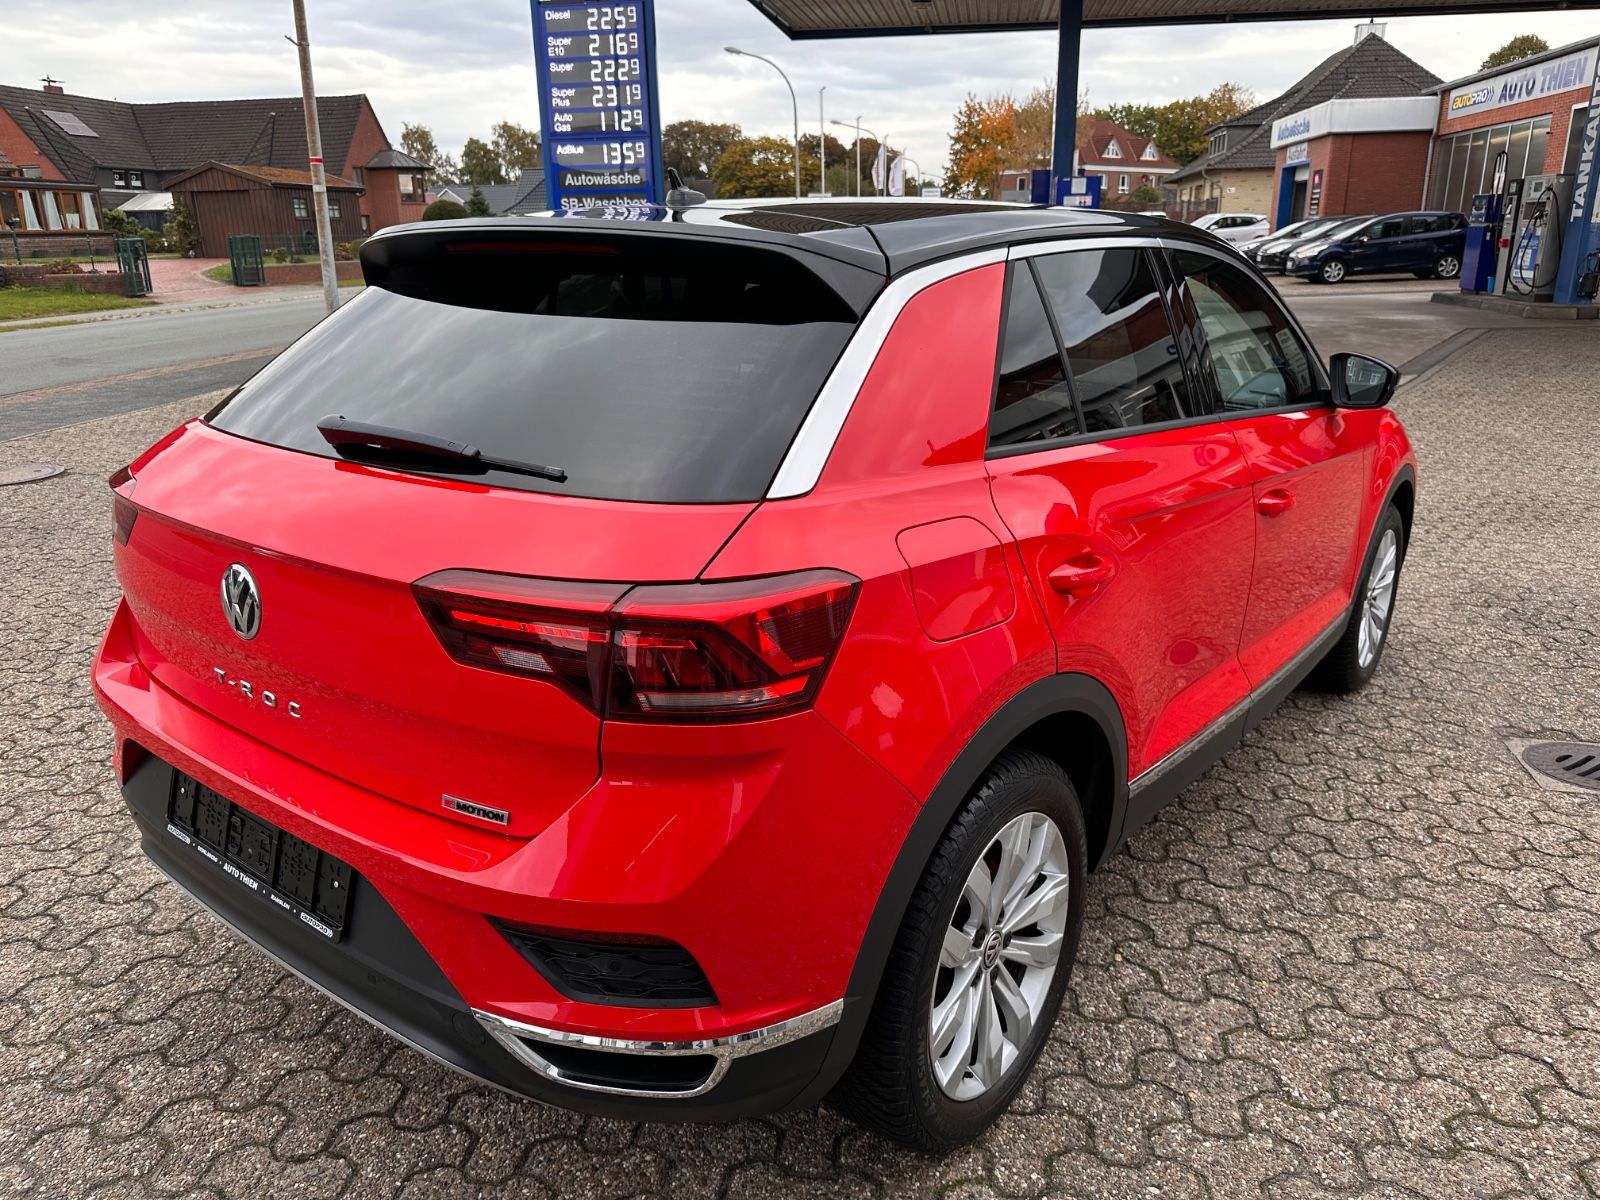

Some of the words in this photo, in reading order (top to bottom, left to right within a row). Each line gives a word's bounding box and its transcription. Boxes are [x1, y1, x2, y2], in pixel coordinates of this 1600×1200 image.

[544, 10, 571, 20] Diesel
[547, 36, 572, 47] Super
[548, 46, 565, 56] E10
[549, 62, 574, 73] Super
[1498, 70, 1537, 103] AUTO
[1540, 56, 1589, 93] THIEN
[551, 88, 576, 98] Super
[552, 98, 570, 107] Plus
[554, 113, 572, 122] Auto
[554, 123, 571, 132] Gas
[1570, 60, 1600, 222] TANKAUT
[556, 144, 584, 155] AdBlue
[565, 172, 641, 186] Autowäsche
[561, 197, 647, 210] SB-Waschbox
[223, 862, 239, 878] AUTO
[240, 871, 259, 891] THIEN
